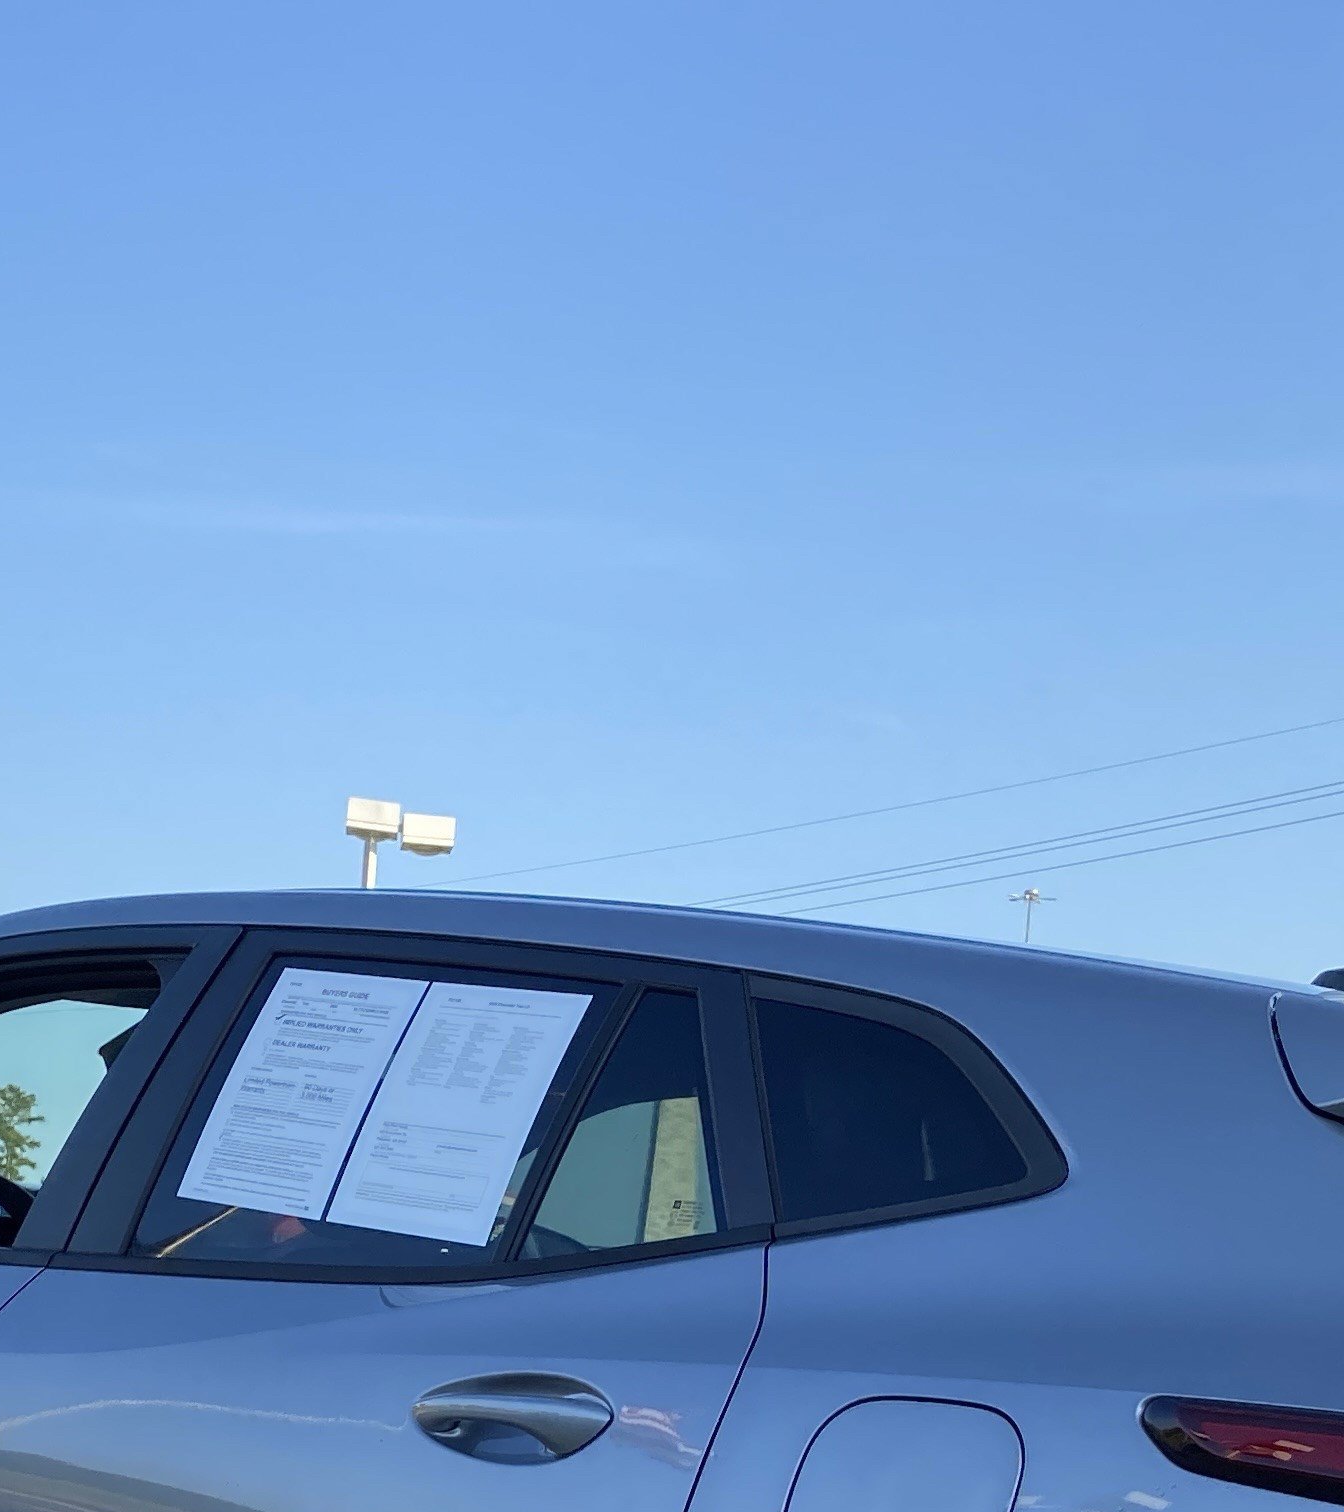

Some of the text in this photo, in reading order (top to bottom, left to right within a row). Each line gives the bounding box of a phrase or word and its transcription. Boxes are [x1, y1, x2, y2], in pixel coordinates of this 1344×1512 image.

[348, 991, 370, 1000] GUIDE
[272, 1039, 331, 1052] DEALER WARRANTY
